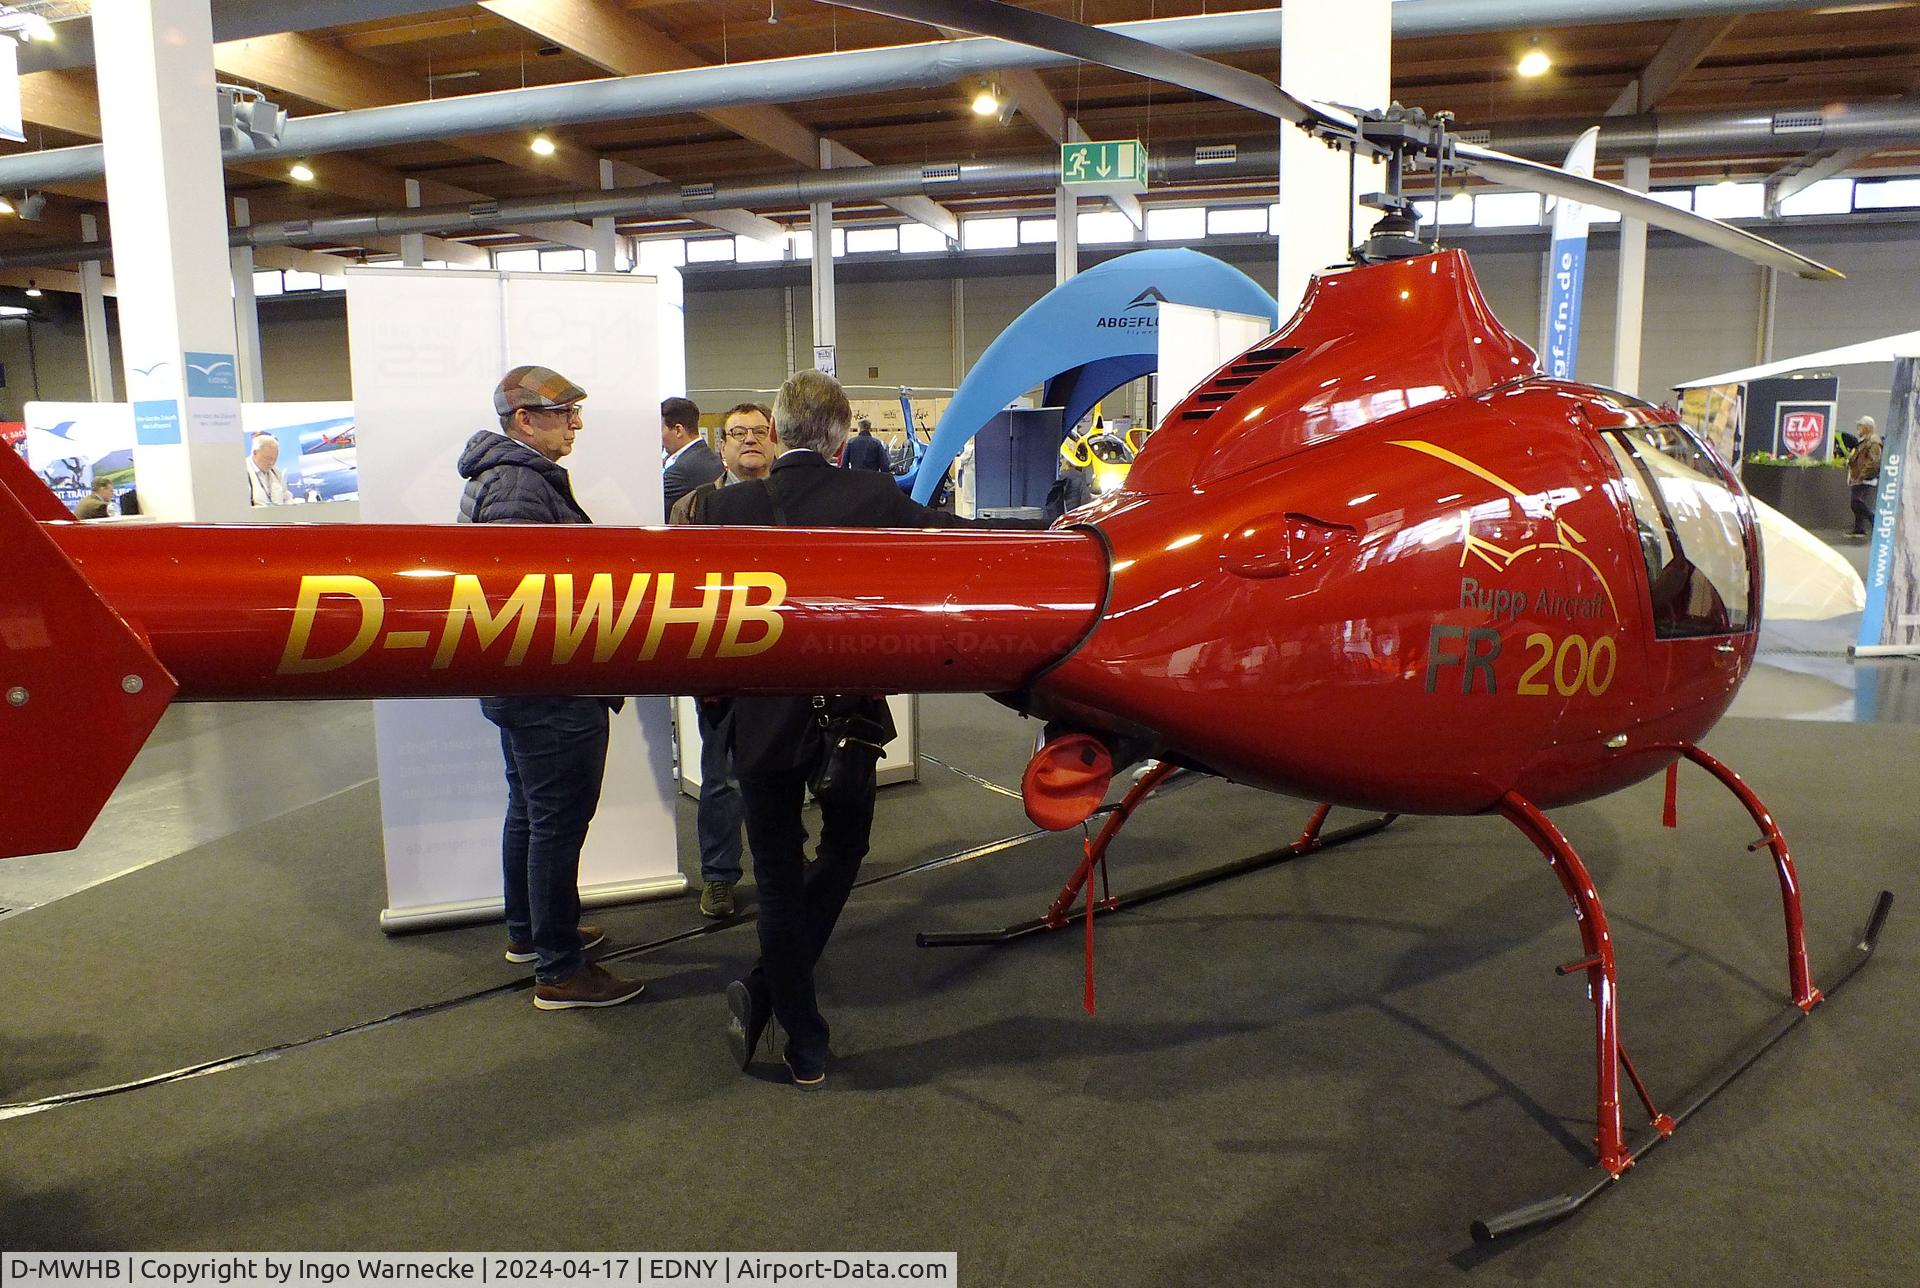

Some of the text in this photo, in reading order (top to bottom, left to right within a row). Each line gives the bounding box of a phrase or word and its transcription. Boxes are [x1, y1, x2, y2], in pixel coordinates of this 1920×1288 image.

[1874, 454, 1899, 587] www.dgf-fn.de
[275, 571, 788, 676] D-MWHB
[1459, 577, 1605, 621] Rupp Aircraft
[1425, 624, 1616, 697] FR 200
